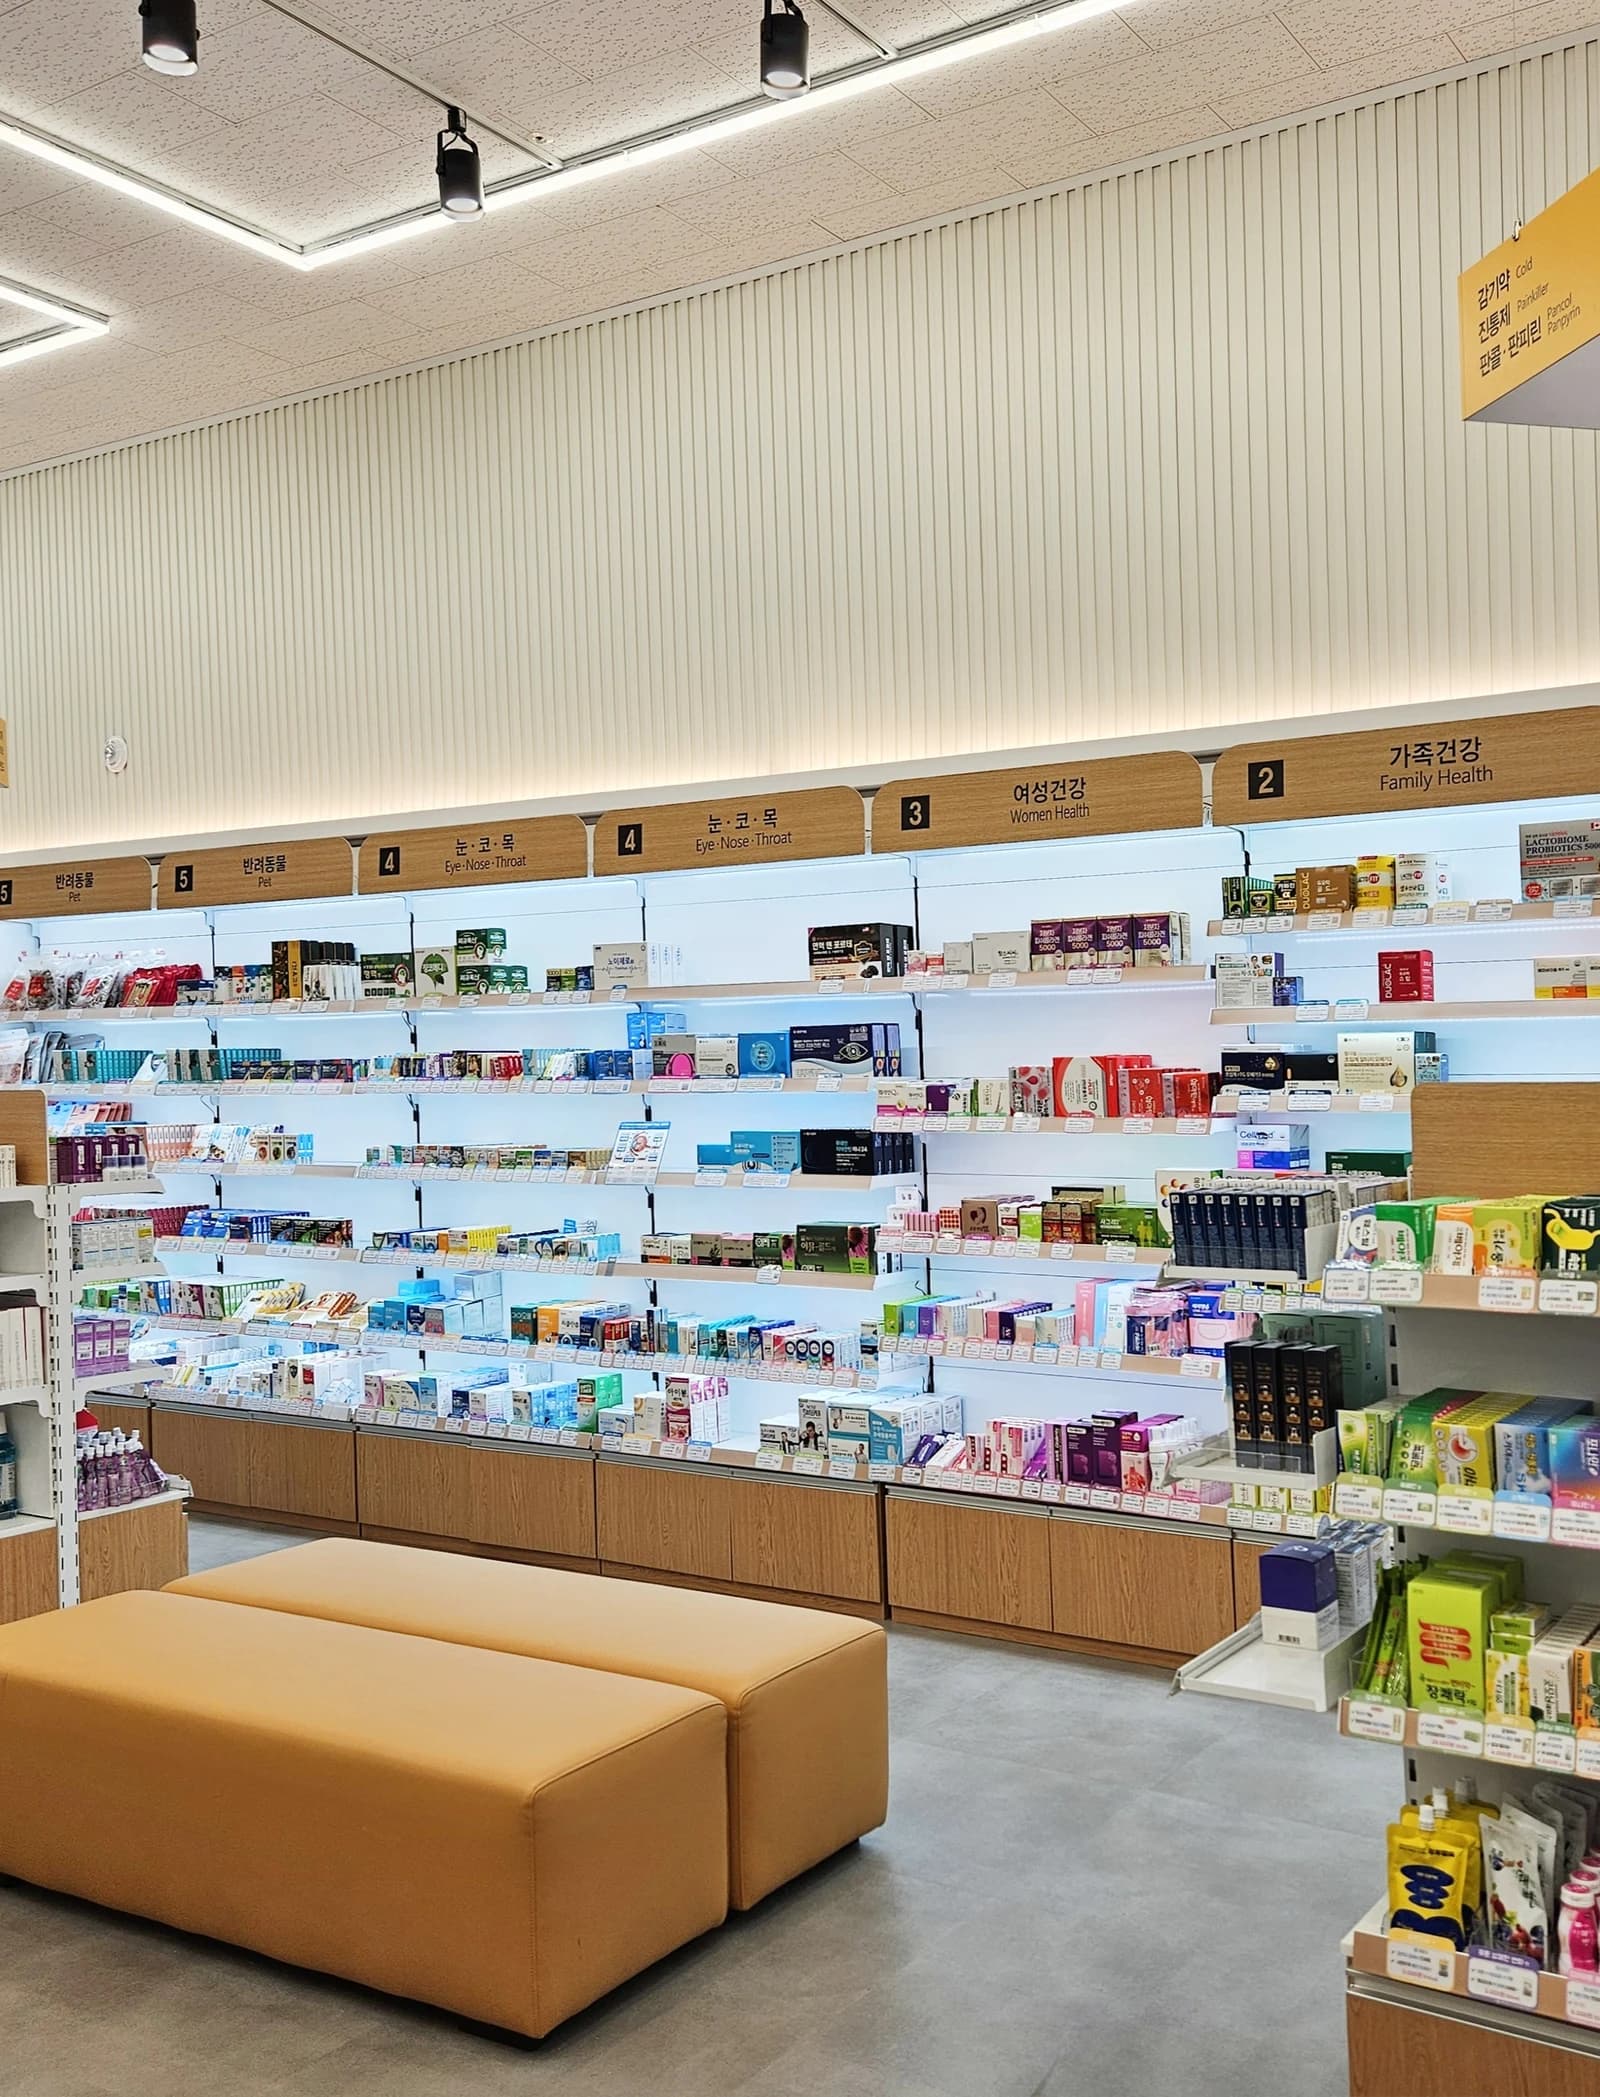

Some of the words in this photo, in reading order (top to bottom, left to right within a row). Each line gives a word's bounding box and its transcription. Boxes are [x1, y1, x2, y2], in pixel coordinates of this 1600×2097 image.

[1478, 268, 1511, 311] 감기약
[1515, 256, 1533, 279] Cold
[1479, 301, 1511, 344] 진통제
[1516, 282, 1549, 312] Painkiller
[1547, 292, 1573, 320] Pancol
[1547, 305, 1581, 335] Panpyrin
[1389, 736, 1482, 769] 가족건강
[1257, 767, 1274, 793] 2
[1380, 769, 1433, 793] Family
[1437, 765, 1494, 785] Health
[1013, 777, 1087, 804] 여성건강
[908, 801, 923, 826] 3
[1010, 806, 1052, 825] Women
[1055, 803, 1090, 821] Health
[624, 829, 637, 851] 4
[1526, 835, 1589, 846] LACTOBIOME
[1526, 843, 1582, 854] PROBIOTICS
[243, 854, 287, 875] 반려동물
[383, 852, 396, 872] 4
[55, 871, 94, 890] 반려동물
[178, 870, 190, 889] 5
[258, 876, 272, 888] Pet
[1301, 872, 1310, 909] DUOLAC
[0, 884, 9, 902] 5
[68, 891, 81, 902] Pet
[1143, 938, 1161, 946] 5000
[1385, 963, 1393, 999] DUOLAC
